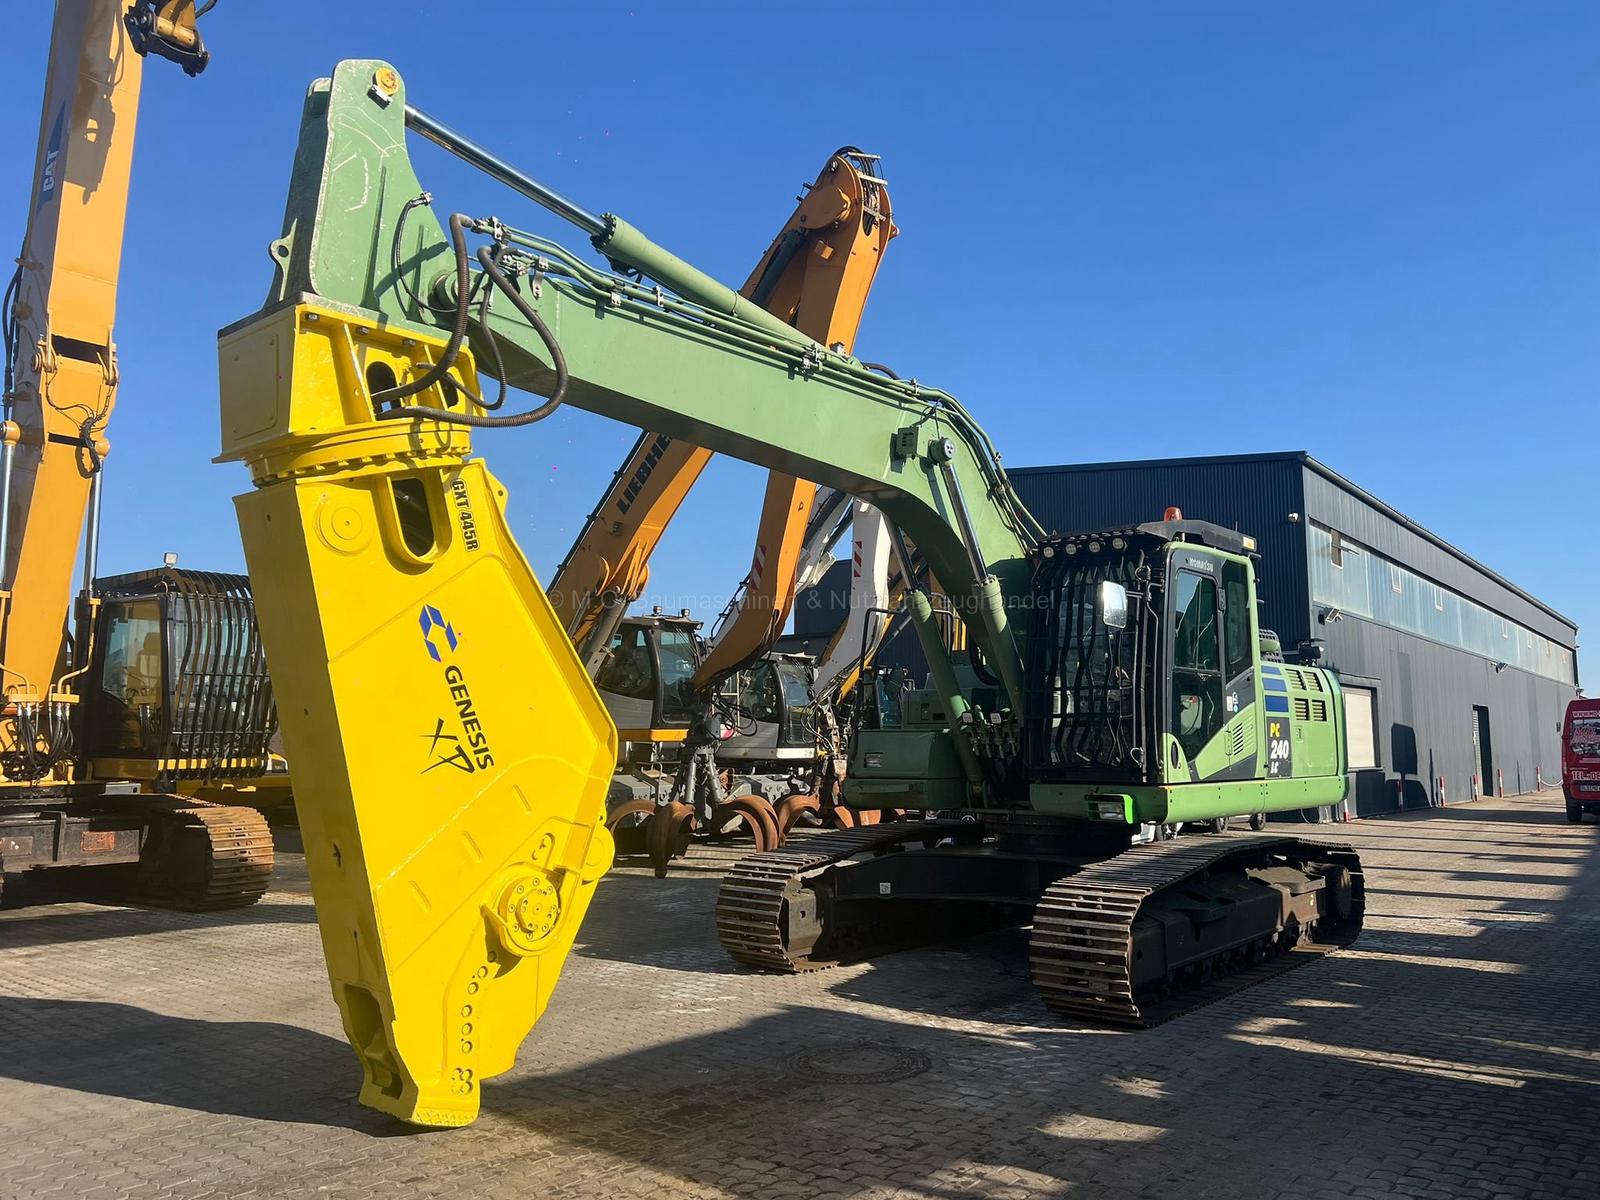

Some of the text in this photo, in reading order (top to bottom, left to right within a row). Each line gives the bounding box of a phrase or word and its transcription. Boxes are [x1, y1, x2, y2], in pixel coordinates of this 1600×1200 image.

[43, 150, 59, 191] CAT
[460, 511, 479, 550] 445R
[445, 665, 494, 770] GENESIS
[1270, 722, 1280, 738] PC
[1270, 739, 1290, 760] 240
